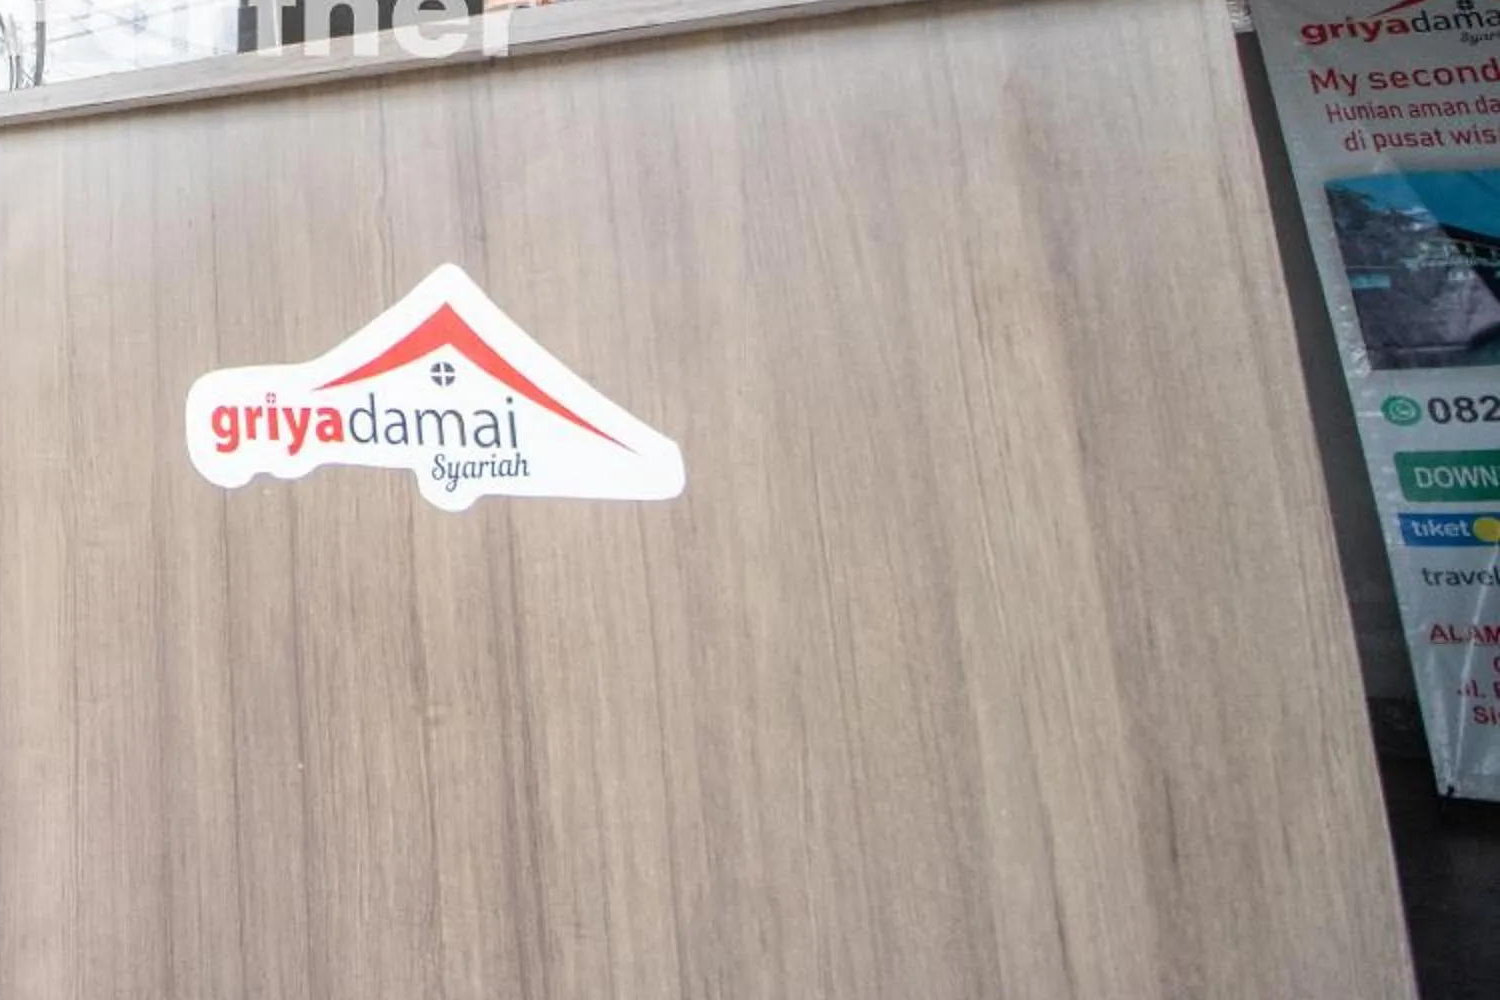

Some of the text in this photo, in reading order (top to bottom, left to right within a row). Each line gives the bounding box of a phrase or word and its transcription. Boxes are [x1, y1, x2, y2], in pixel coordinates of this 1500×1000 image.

[1309, 56, 1500, 96] My second
[1325, 103, 1402, 124] Hunian
[1409, 100, 1470, 118] aman
[1343, 130, 1367, 152] di
[1373, 129, 1445, 153] pusat
[1428, 395, 1500, 424] 082
[431, 452, 530, 492] Syariah
[1414, 465, 1499, 488] DOWN
[1411, 519, 1471, 537] tiket
